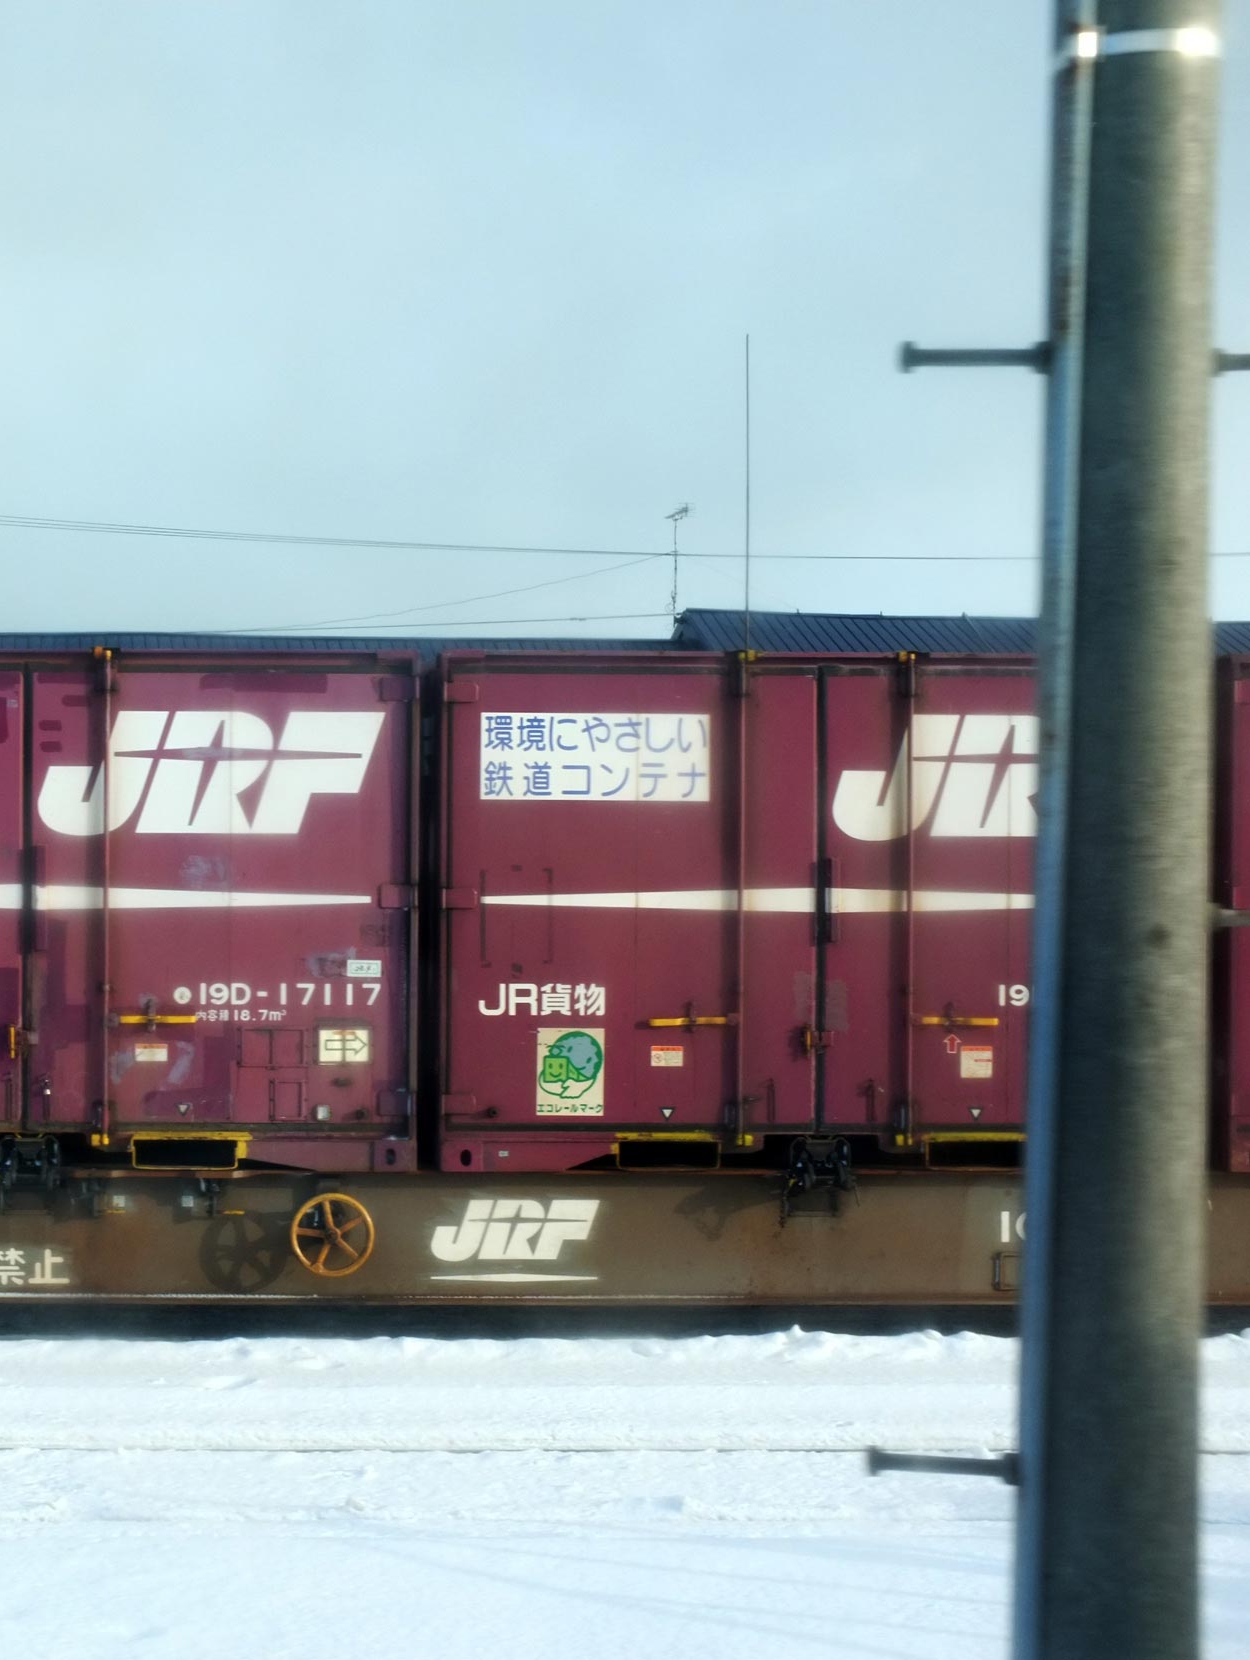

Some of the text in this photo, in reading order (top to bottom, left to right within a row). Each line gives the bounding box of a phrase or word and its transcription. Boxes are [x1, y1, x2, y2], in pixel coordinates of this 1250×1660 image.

[484, 716, 707, 753] 環境にやさしい
[38, 711, 386, 836] JRF
[484, 761, 706, 798] 鉄道コンテナ
[833, 714, 1039, 841] JR
[478, 983, 605, 1016] JR貨物
[998, 984, 1031, 1006] 19
[537, 1104, 603, 1114] エコレールマーク
[431, 1200, 600, 1261] JRF
